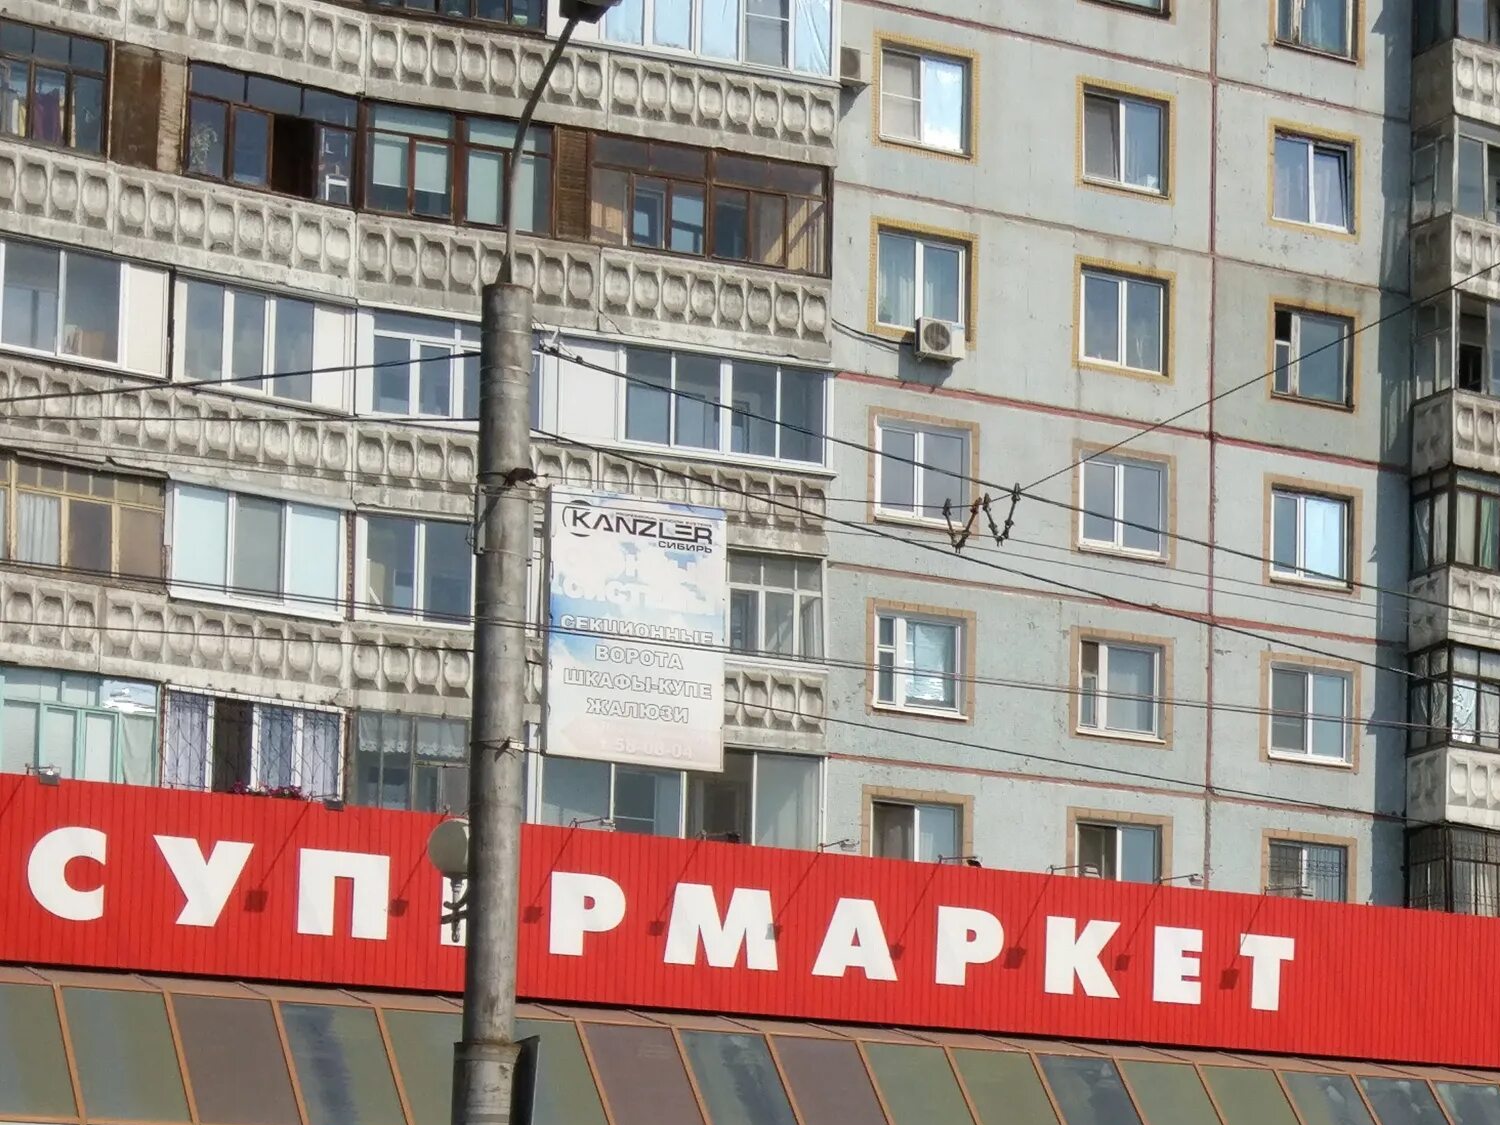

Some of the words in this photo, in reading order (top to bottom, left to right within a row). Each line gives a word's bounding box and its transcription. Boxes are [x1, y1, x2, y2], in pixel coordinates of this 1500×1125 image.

[571, 507, 713, 545] KANZLER
[658, 540, 713, 554] СИБИРЬ
[560, 614, 714, 646] СЕКЦИОННЫЕ
[594, 644, 684, 671] ВОРОТА
[563, 667, 713, 700] ШКАФЫ-КУПЕ
[586, 697, 690, 724] ЖАЛЮЗИ
